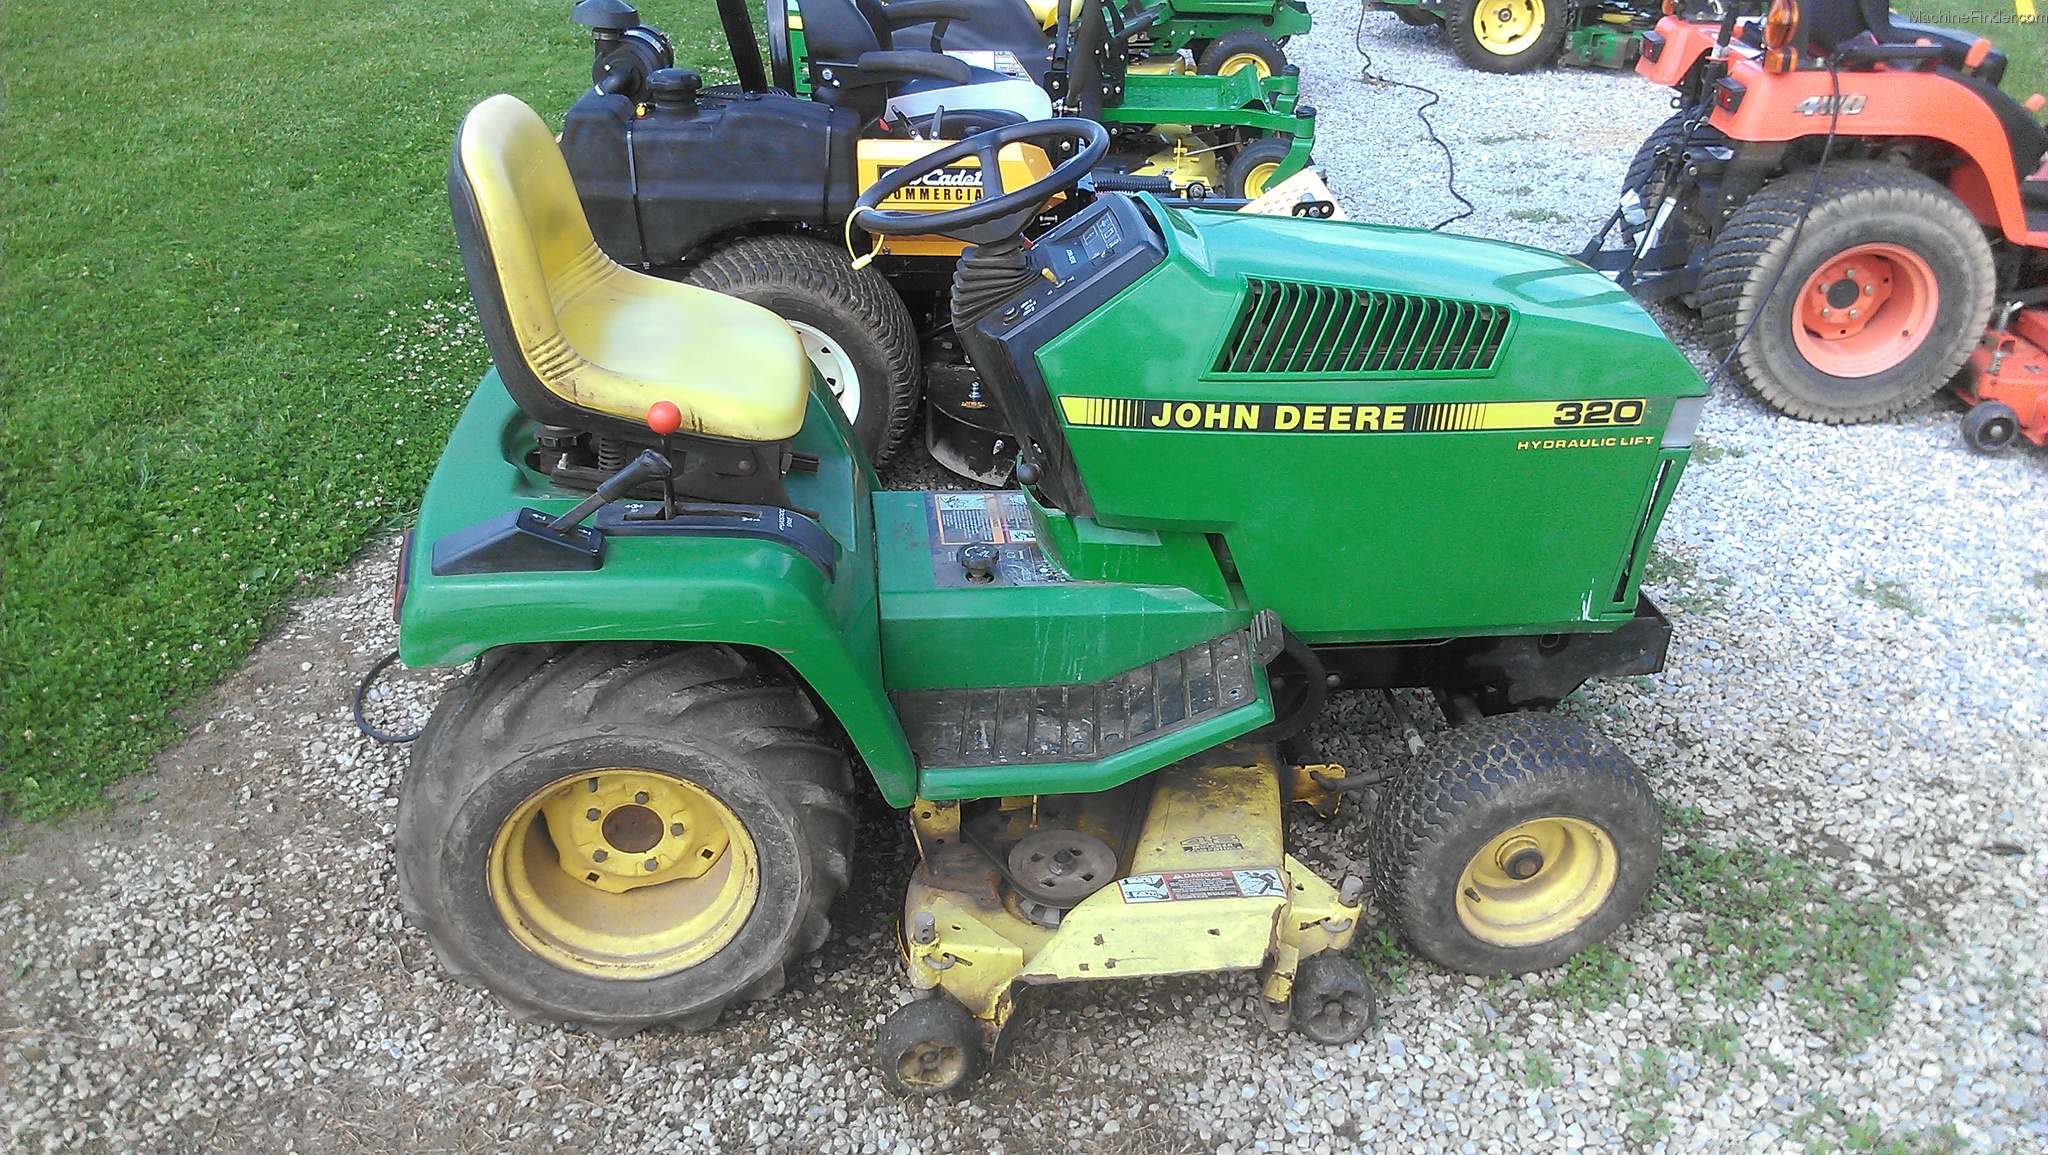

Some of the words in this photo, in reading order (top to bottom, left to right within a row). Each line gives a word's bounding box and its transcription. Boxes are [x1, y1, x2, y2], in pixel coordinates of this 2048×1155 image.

[922, 168, 984, 187] Cadet
[892, 187, 983, 201] OMMERCIA
[1151, 402, 1260, 430] JOHN
[1274, 405, 1407, 431] DEERE
[1553, 400, 1644, 425] 320
[1517, 437, 1617, 450] HYDRAULIC
[1619, 436, 1655, 447] LIFT
[1183, 871, 1224, 879] DANGER
